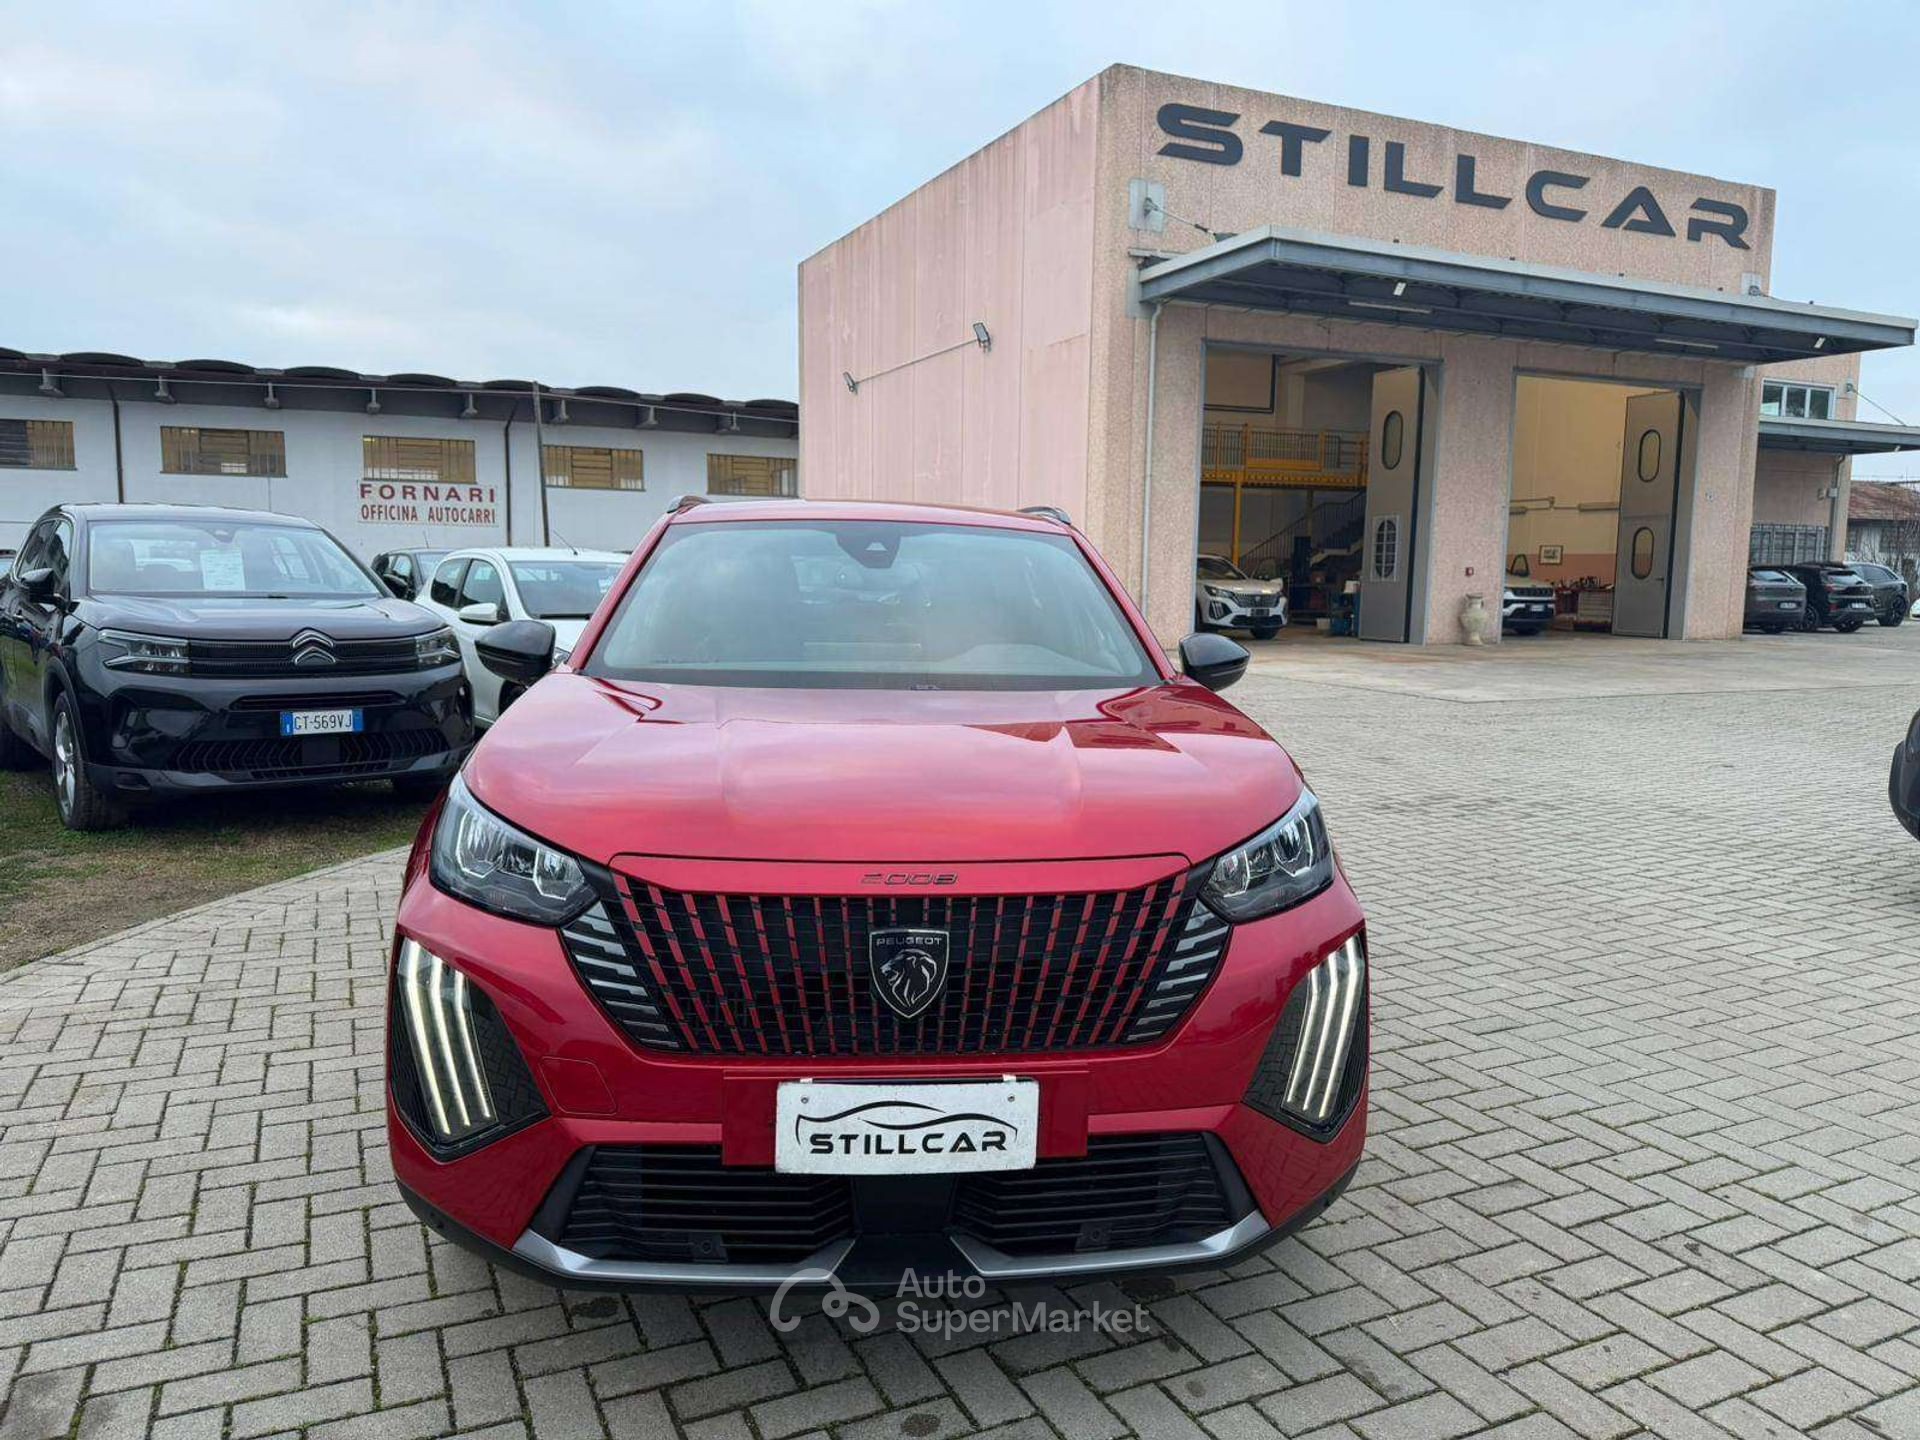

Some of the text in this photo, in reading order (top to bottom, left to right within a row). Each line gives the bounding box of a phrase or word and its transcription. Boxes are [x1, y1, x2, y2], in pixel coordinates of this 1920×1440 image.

[1157, 103, 1751, 250] STILLCAR
[360, 483, 496, 503] FORNARI
[361, 504, 496, 524] OFFICINA AUTOCARRI
[861, 873, 958, 886] 2008
[876, 936, 942, 946] PEUGEOT
[809, 1131, 1007, 1155] STILLCAR
